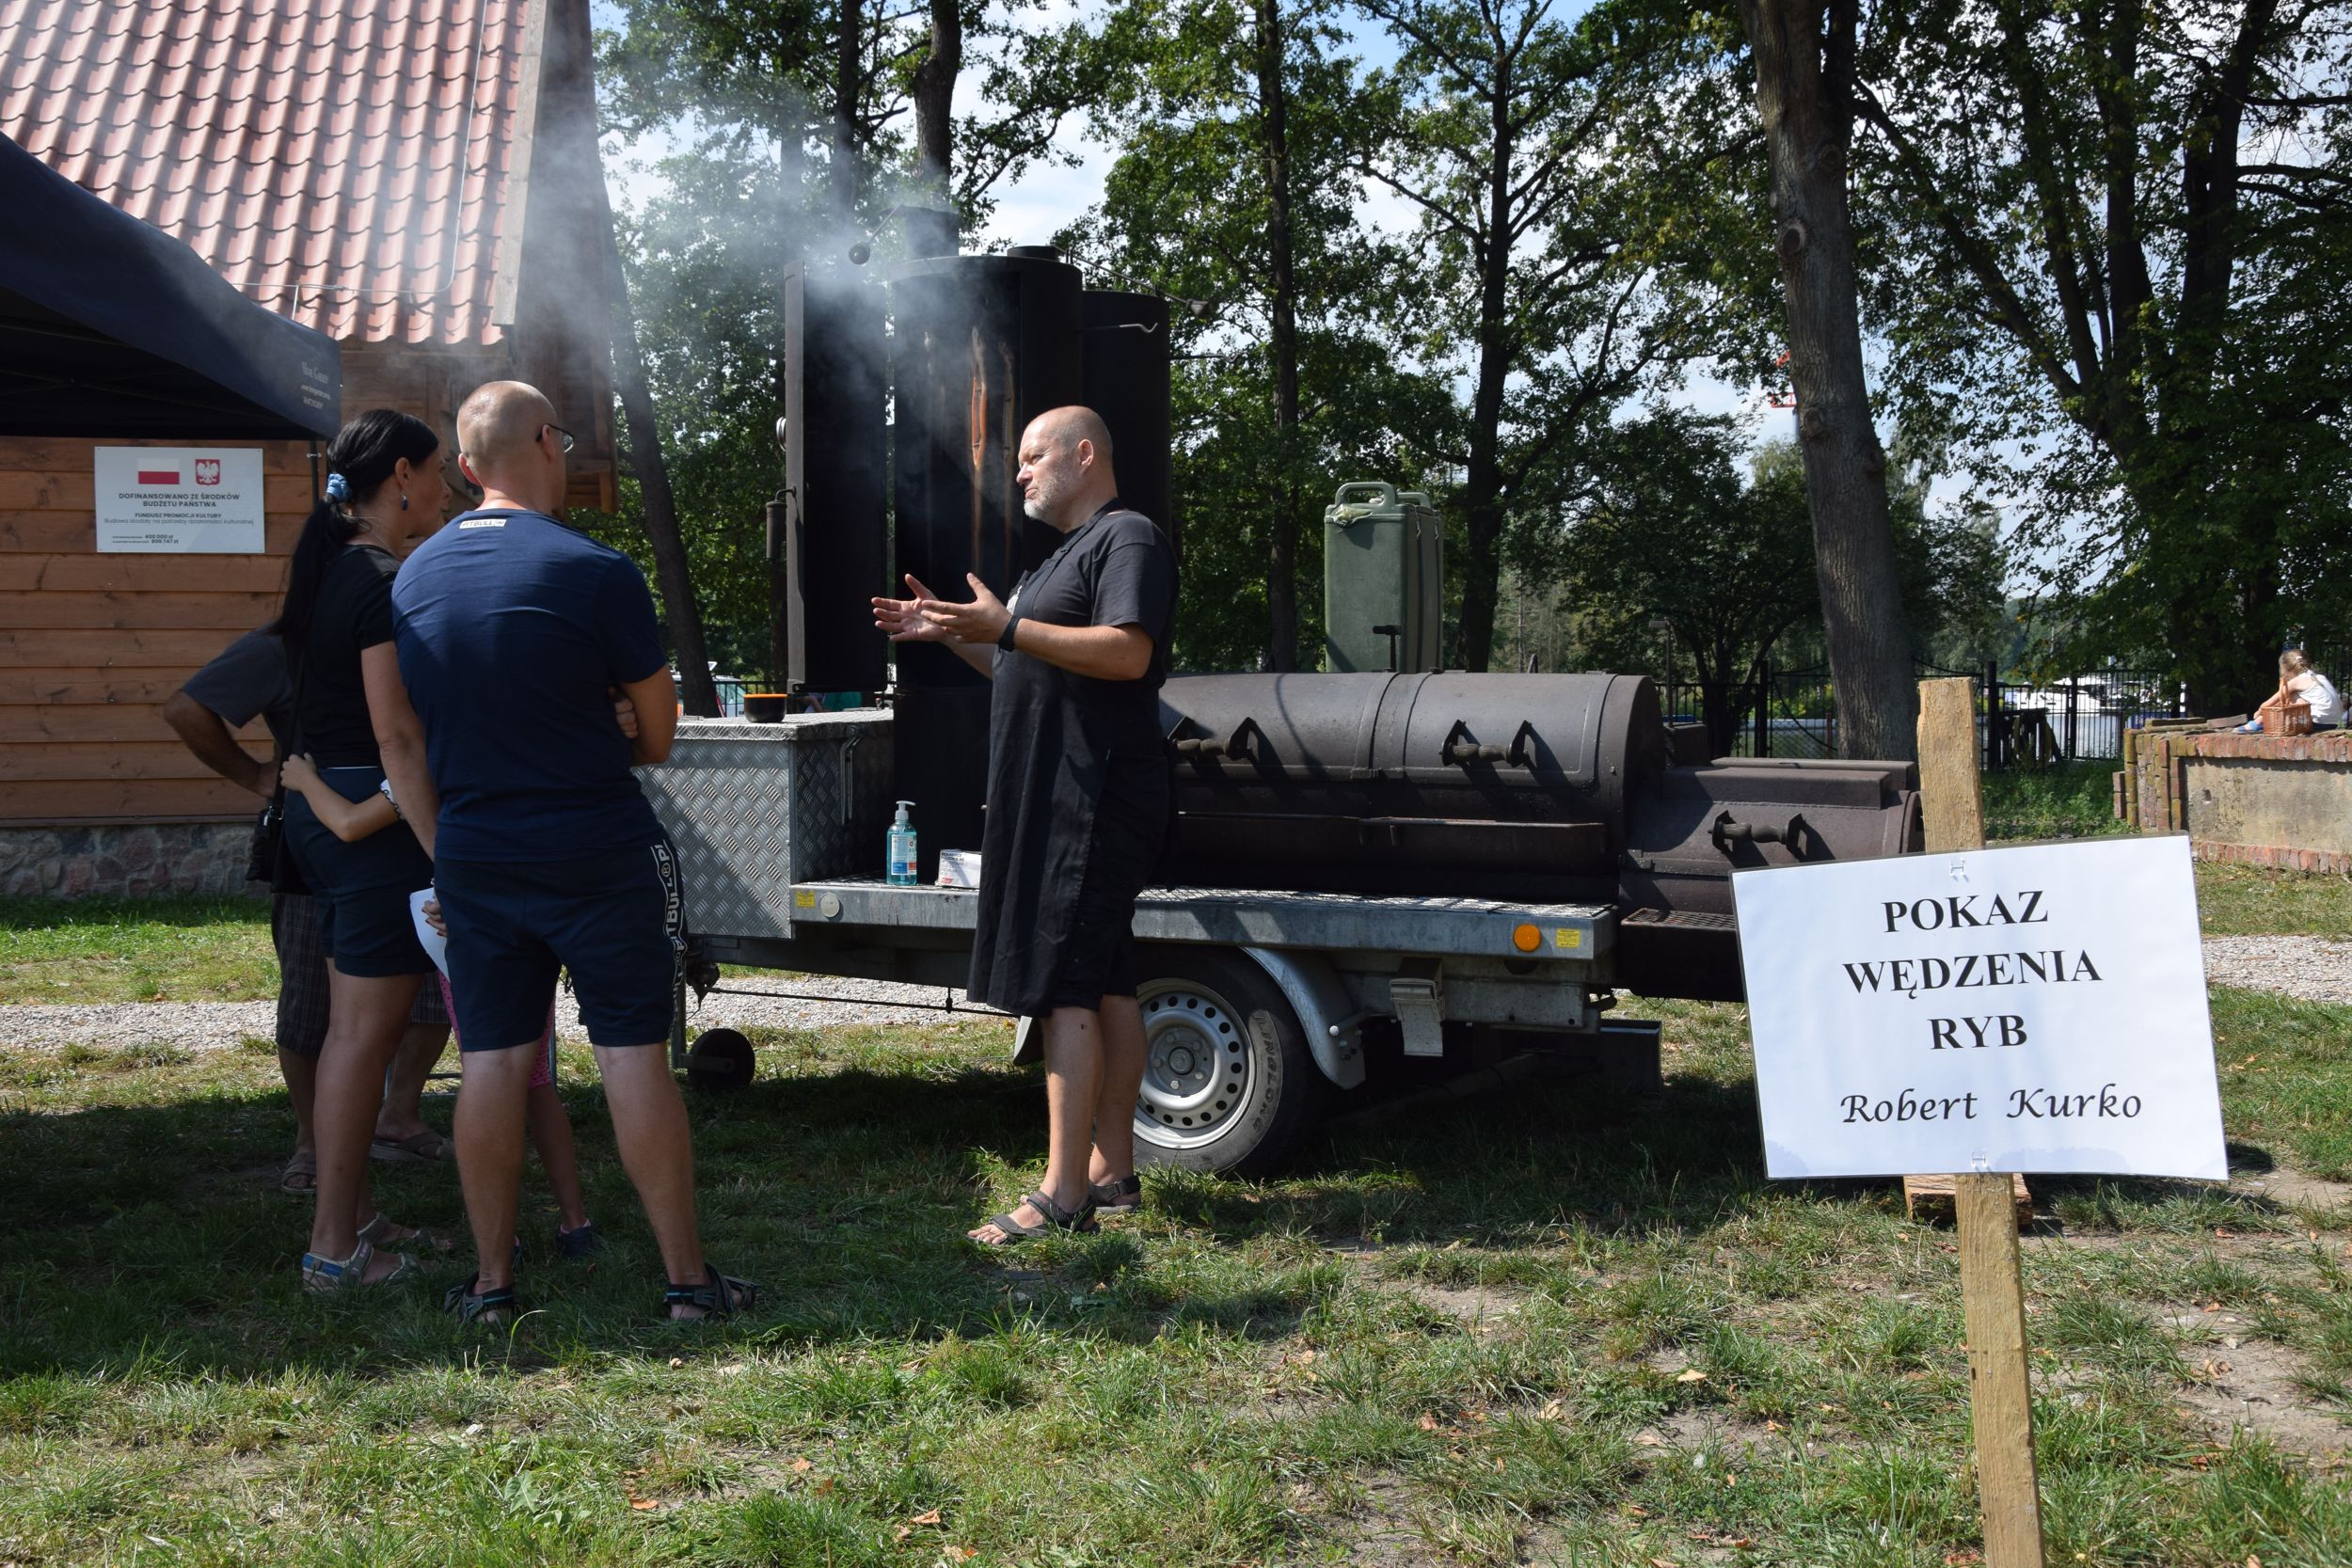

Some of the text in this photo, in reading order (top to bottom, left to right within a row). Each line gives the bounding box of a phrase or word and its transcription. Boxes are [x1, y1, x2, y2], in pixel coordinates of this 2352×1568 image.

[200, 492, 240, 500] ŚRODKÓW
[1882, 890, 2048, 933] POKAZ
[1842, 949, 2104, 1000] WĘDZENIA
[1928, 1014, 2027, 1050] RYB
[1840, 1083, 2142, 1123] Robert Kurko
